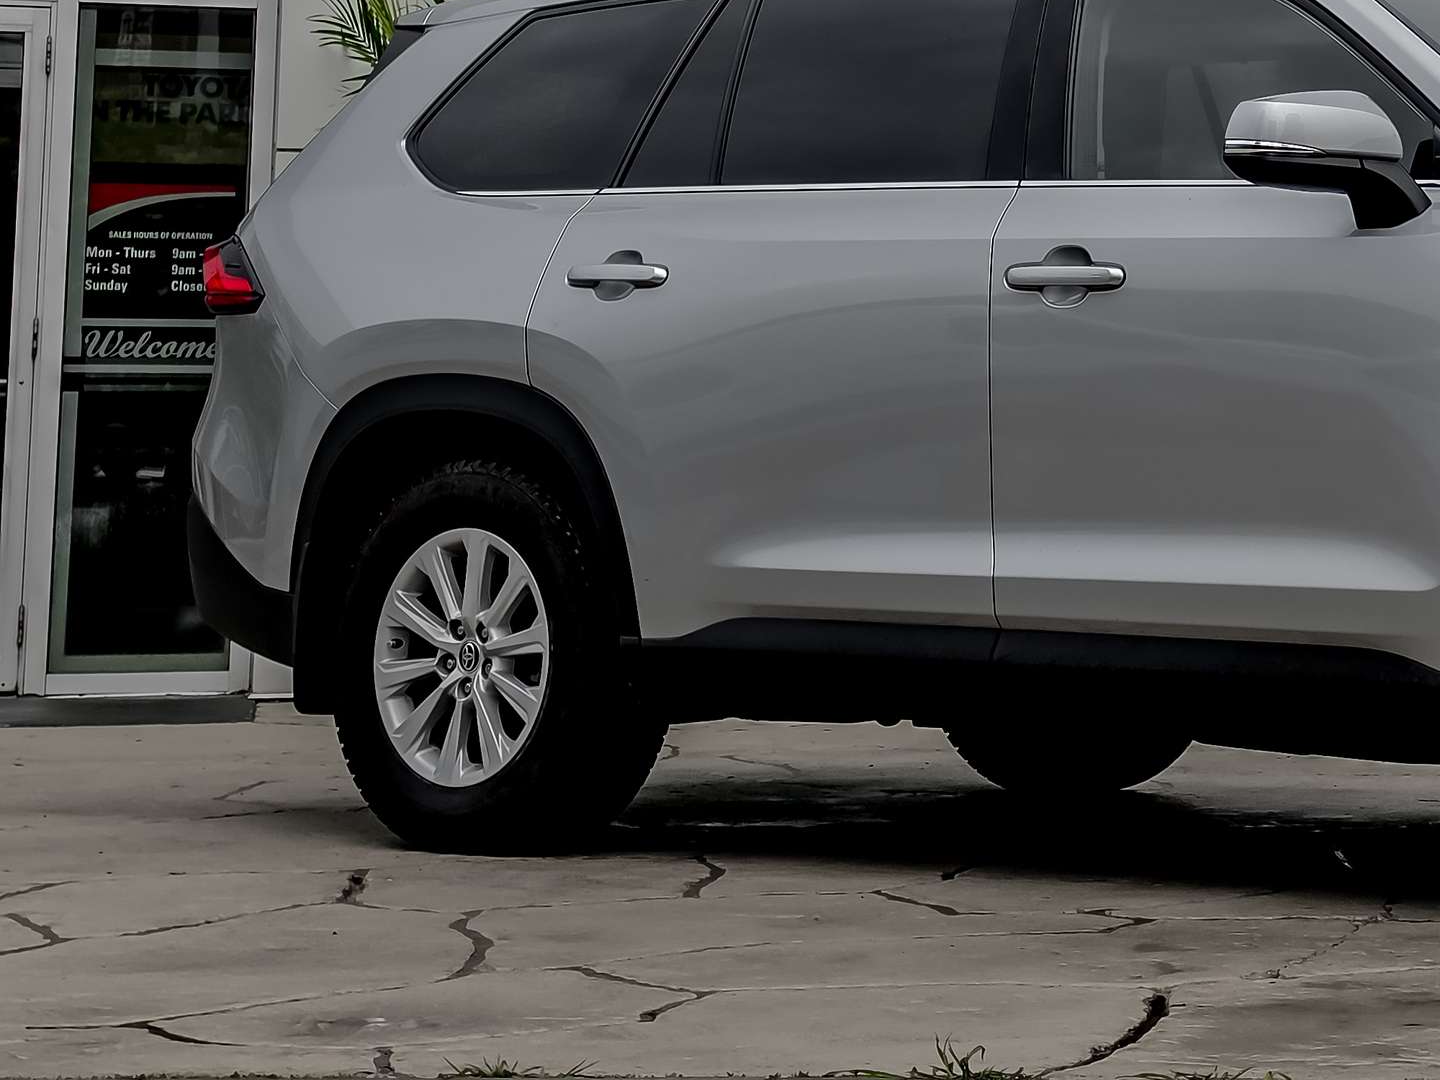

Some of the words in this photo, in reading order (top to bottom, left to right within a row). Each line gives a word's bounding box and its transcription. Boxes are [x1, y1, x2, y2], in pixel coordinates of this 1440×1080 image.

[109, 230, 132, 239] SALES
[133, 231, 159, 239] HOURS
[171, 232, 213, 240] OPERATION
[86, 246, 112, 258] Mon
[123, 246, 156, 259] Thurs
[172, 248, 196, 259] 9am
[85, 263, 100, 274] Fri
[111, 263, 131, 275] Sat
[171, 264, 195, 275] 9am
[85, 279, 128, 294] Sunday
